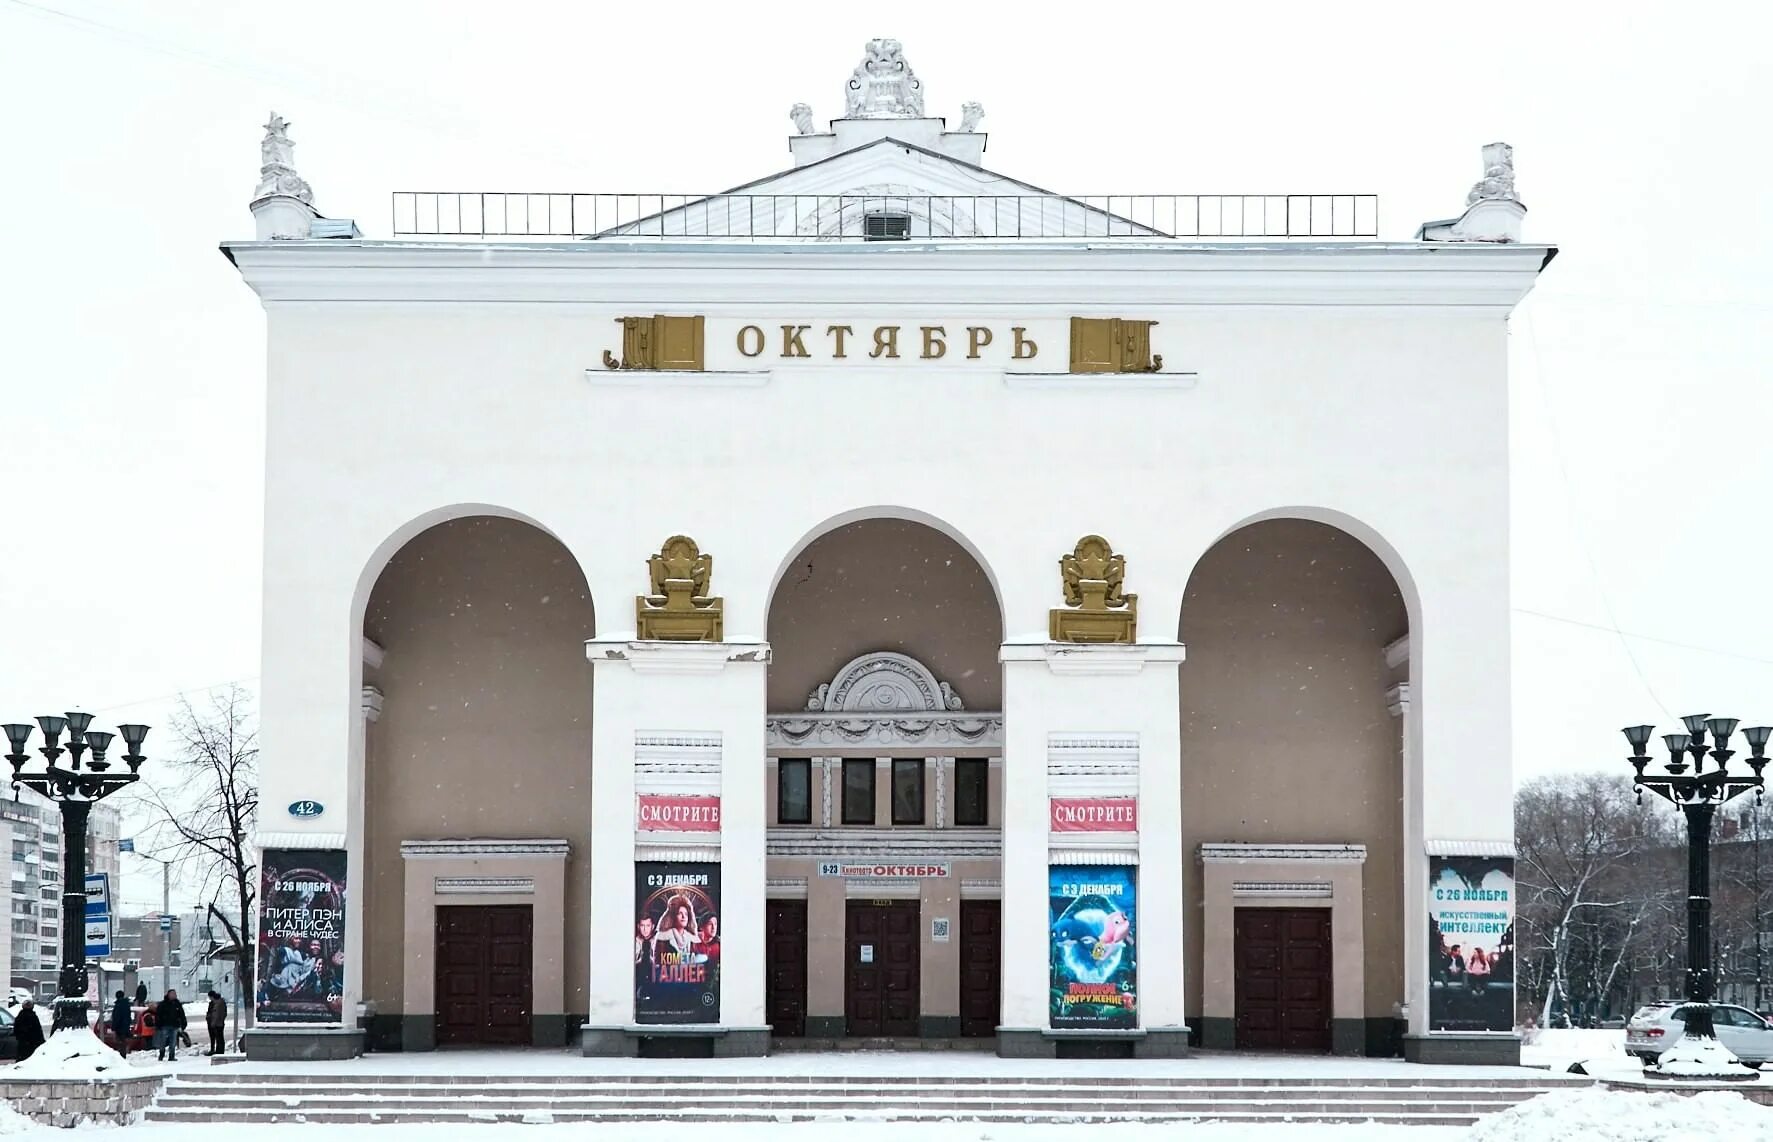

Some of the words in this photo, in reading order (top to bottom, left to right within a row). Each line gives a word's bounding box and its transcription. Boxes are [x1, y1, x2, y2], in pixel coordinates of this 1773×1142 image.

[736, 325, 1039, 360] ОКТЯБРЬ
[296, 801, 314, 814] 42
[641, 805, 719, 822] СМОТРИТЕ
[1055, 806, 1134, 822] СМОТРИТЕ
[873, 866, 946, 876] ОКТЯБРЬ
[275, 881, 281, 891] С
[283, 882, 294, 891] 26
[296, 882, 331, 892] НОЯБРЯ
[648, 875, 655, 885] С
[656, 875, 663, 885] 3
[664, 874, 708, 887] ДЕКАБРЯ
[1062, 884, 1070, 895] С
[1071, 884, 1077, 895] 3
[1079, 883, 1123, 896] ДЕКАБРЯ
[1436, 889, 1443, 900] С
[1447, 889, 1460, 900] 26
[1463, 890, 1508, 901] НОЯБРЯ
[266, 908, 309, 919] ПИТЕР
[313, 909, 342, 920] ПЭН
[284, 920, 333, 931] АЛИСА
[275, 930, 308, 938] СТРАНЕ
[310, 931, 339, 939] ЧУДЕС
[660, 952, 696, 965] КОМЕТА
[1121, 980, 1133, 991] 6+
[326, 992, 337, 1002] 6+
[1063, 994, 1122, 1005] ПОГРУЖЕНИЕ
